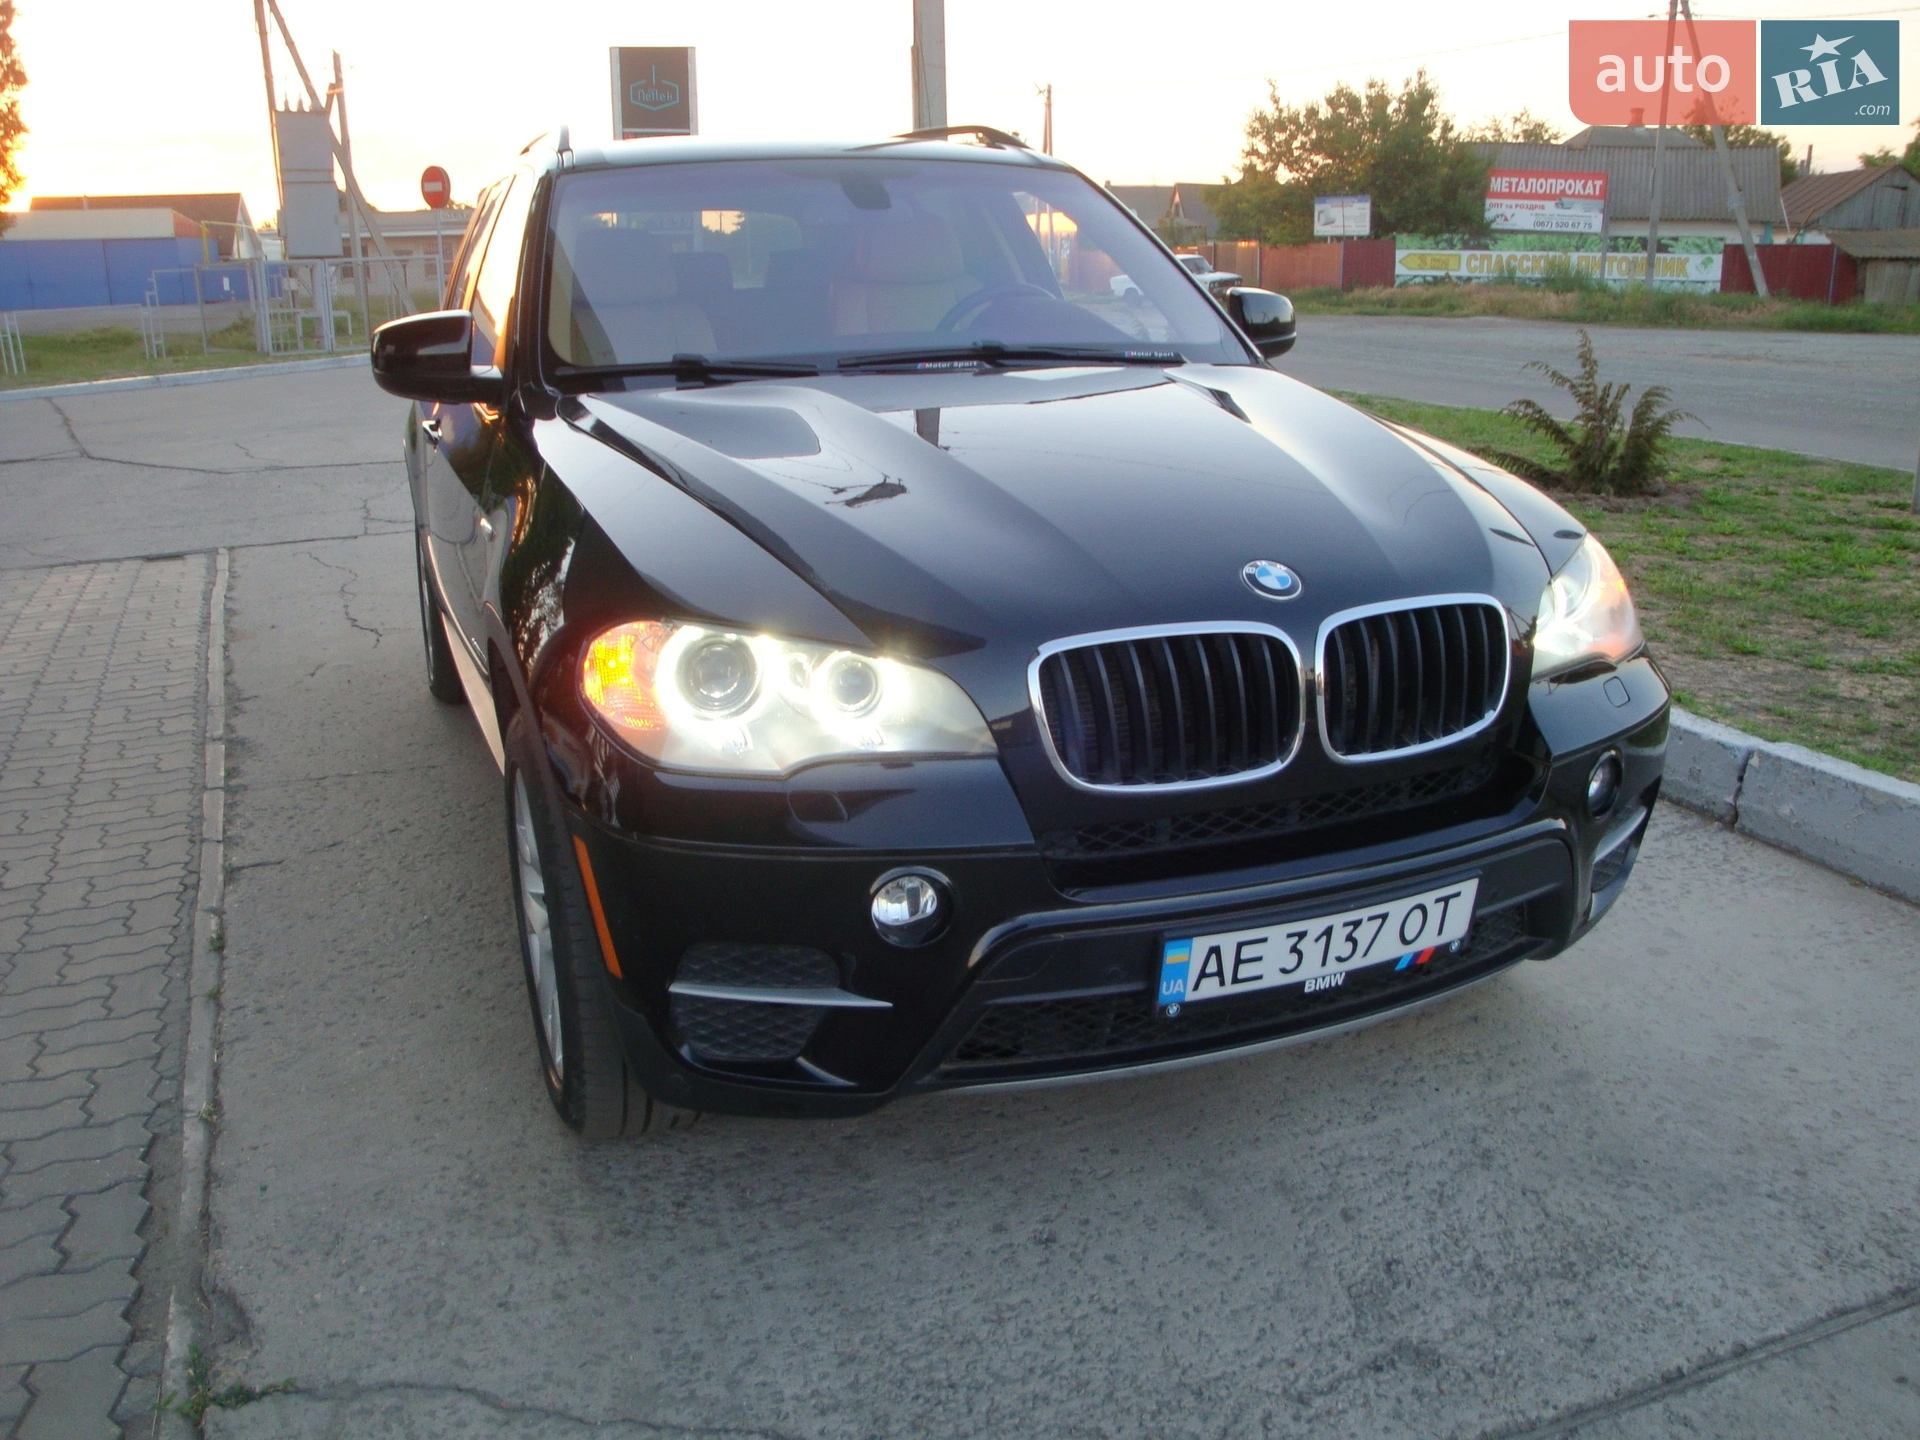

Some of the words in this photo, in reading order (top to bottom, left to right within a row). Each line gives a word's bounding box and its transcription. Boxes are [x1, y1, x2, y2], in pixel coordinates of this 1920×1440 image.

[1490, 177, 1602, 196] МЕТАЛОПРОКАТ
[1191, 935, 1269, 992] AE
[1278, 911, 1390, 975] 3137
[1399, 891, 1462, 946] OT
[1162, 979, 1185, 996] UA
[1304, 972, 1346, 993] BMW
